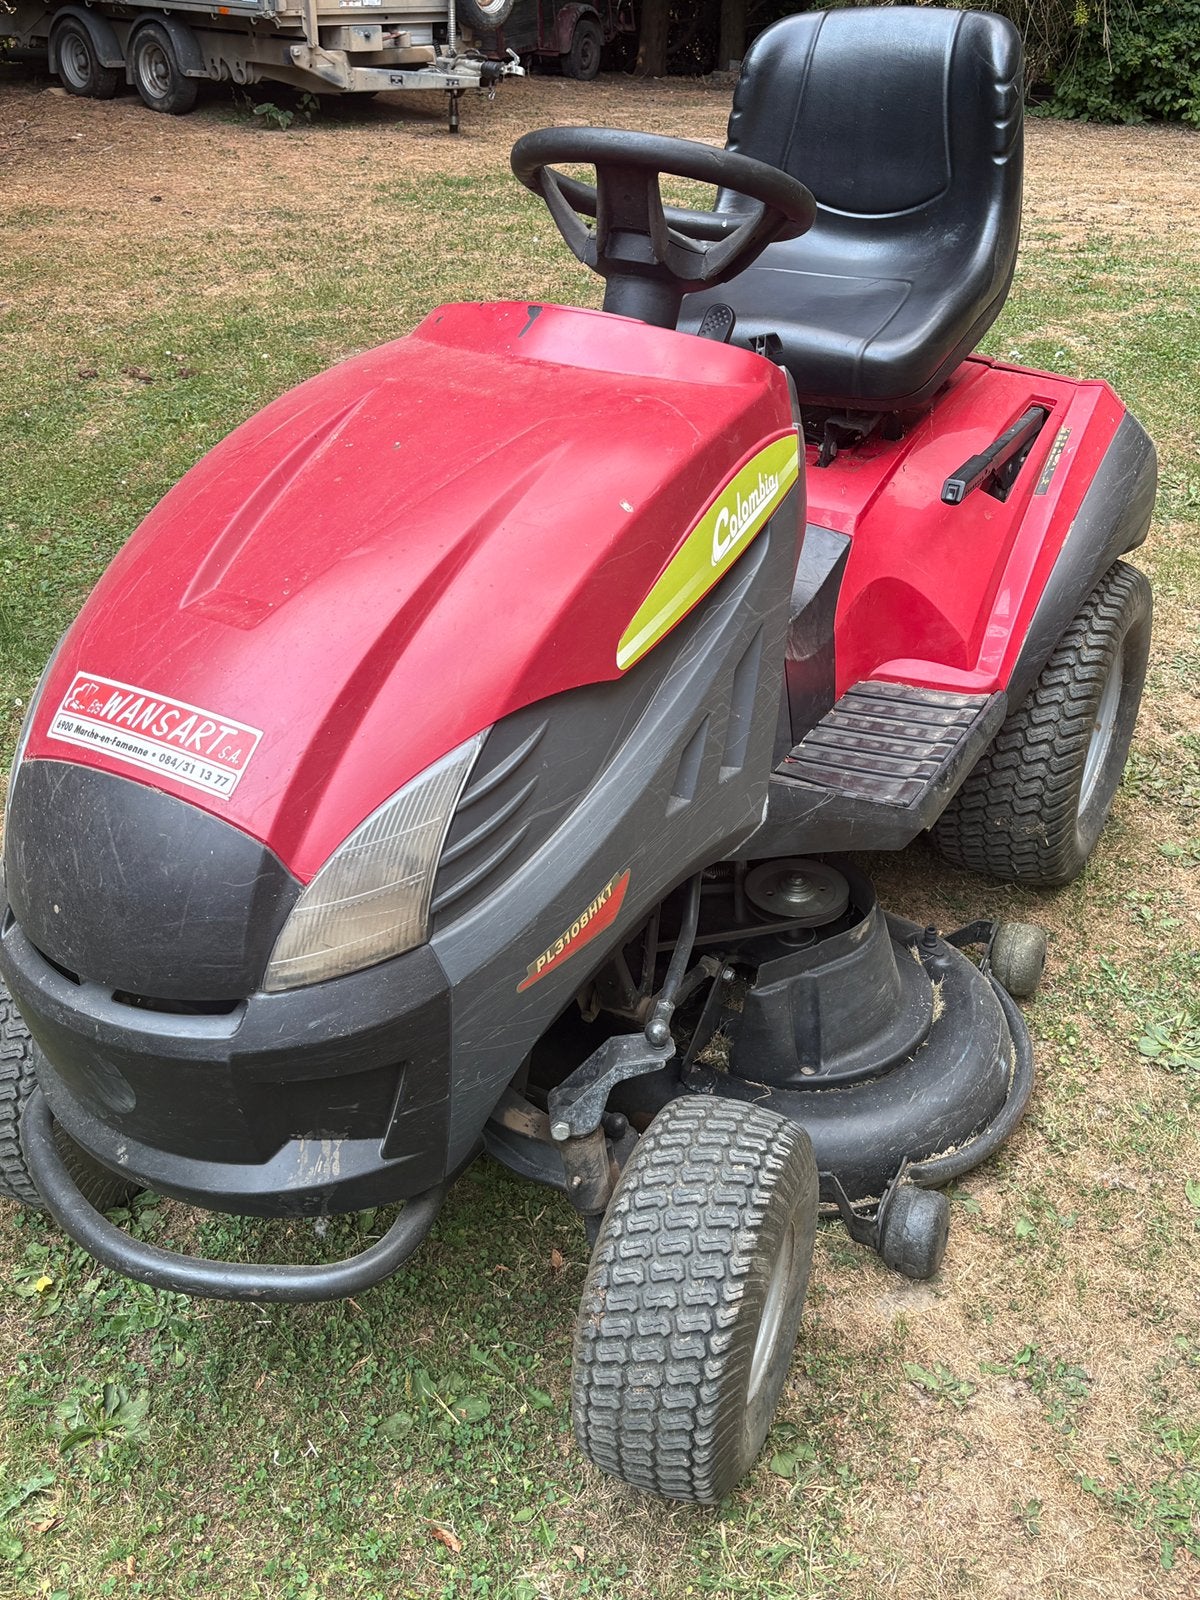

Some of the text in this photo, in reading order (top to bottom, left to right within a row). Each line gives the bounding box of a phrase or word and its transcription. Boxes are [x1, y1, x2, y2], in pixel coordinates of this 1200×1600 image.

[711, 472, 779, 567] Colombia
[56, 718, 231, 787] 6900 Marche-en-Famenne 084/31 13 77
[100, 691, 238, 755] WANSART
[218, 745, 240, 764] S.A.
[536, 882, 613, 973] PL3108HKT
